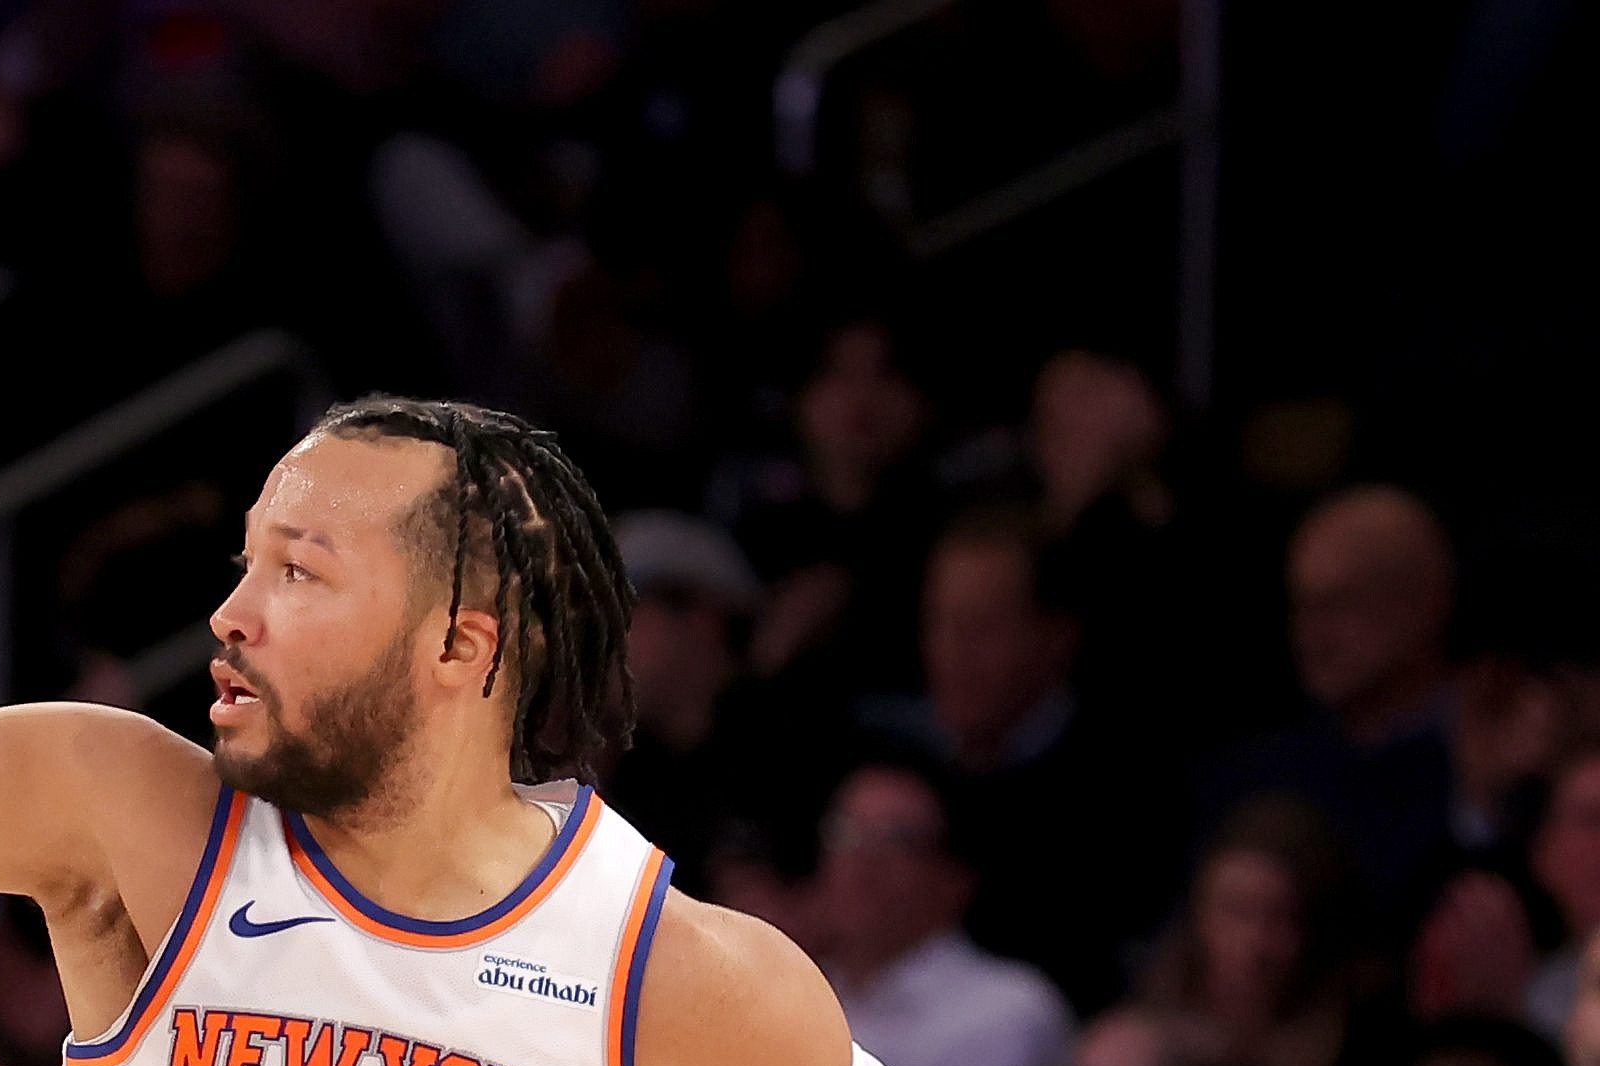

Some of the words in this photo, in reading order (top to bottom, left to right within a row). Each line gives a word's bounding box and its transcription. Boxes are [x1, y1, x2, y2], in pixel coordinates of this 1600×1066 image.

[483, 953, 547, 974] experience
[477, 966, 525, 991] abu
[527, 975, 598, 1007] dhabi
